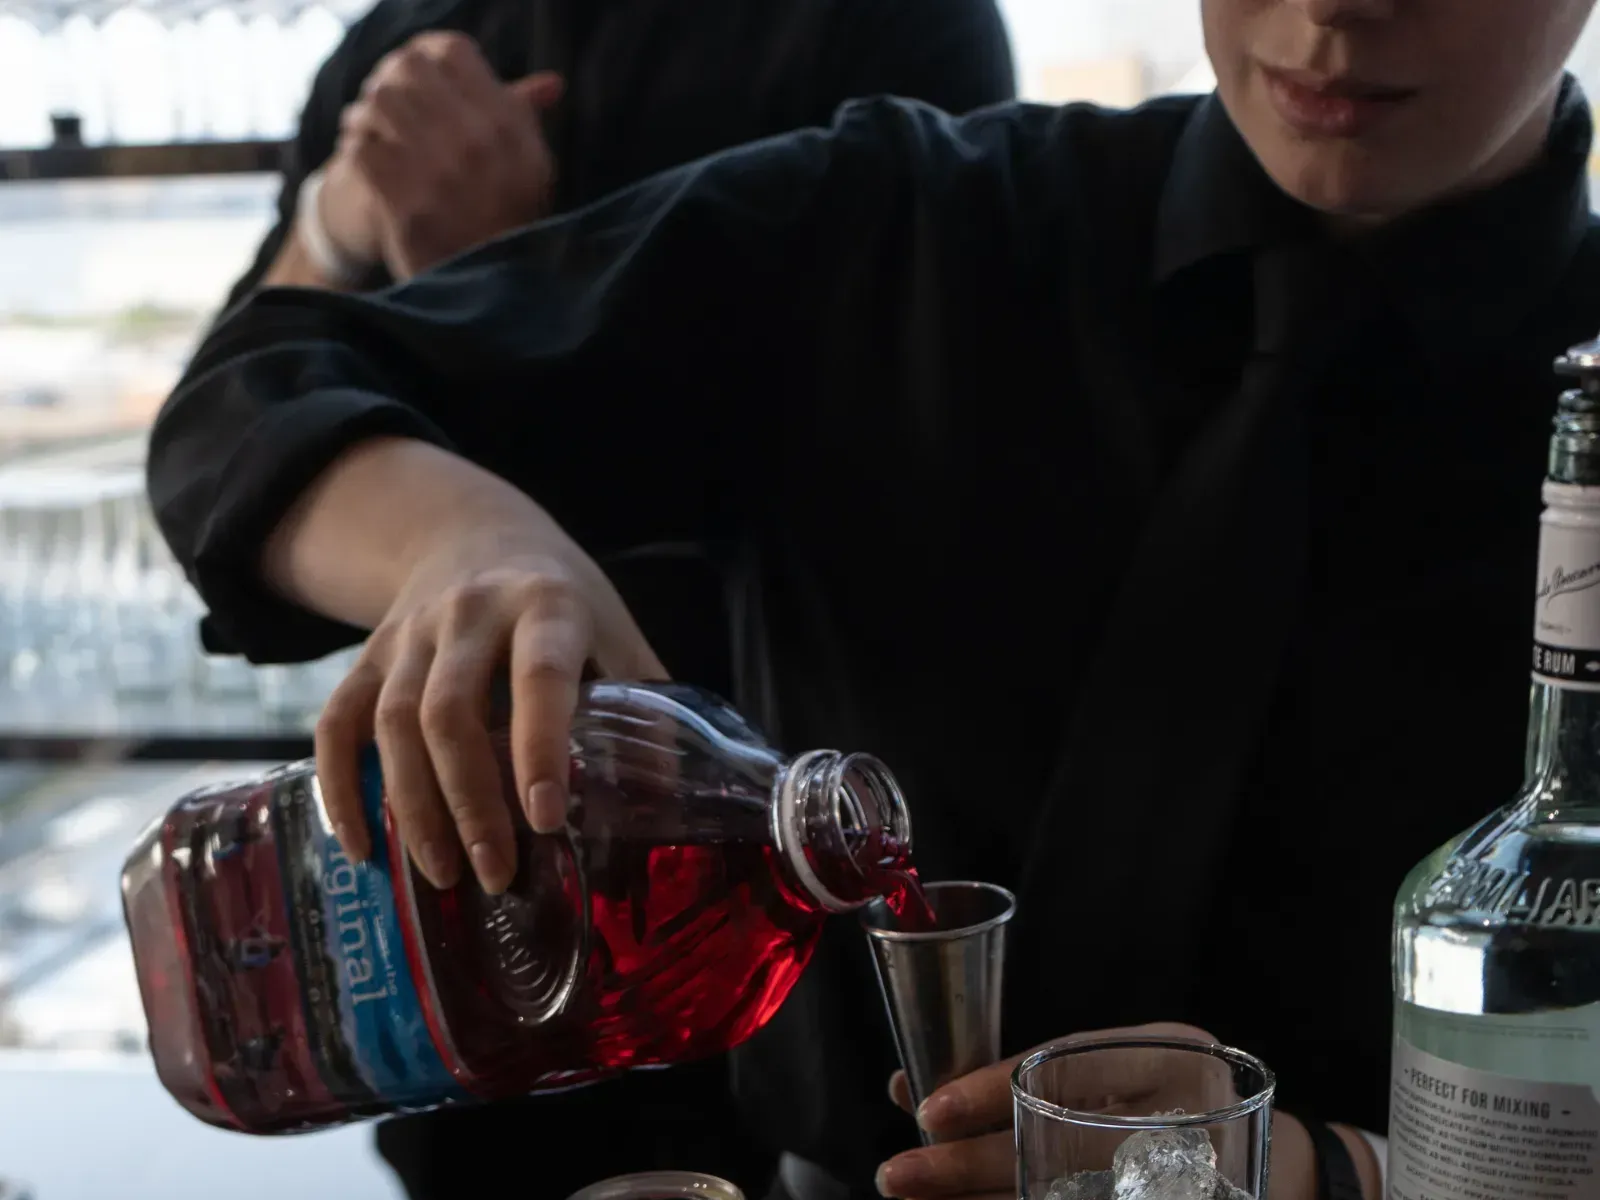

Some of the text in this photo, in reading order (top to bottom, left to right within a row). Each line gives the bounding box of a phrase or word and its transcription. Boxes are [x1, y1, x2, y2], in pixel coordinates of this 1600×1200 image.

[1543, 649, 1576, 676] RUM
[1411, 1067, 1459, 1101] PERFECT
[1462, 1087, 1488, 1110] FOR
[1494, 1095, 1551, 1120] MIXING
